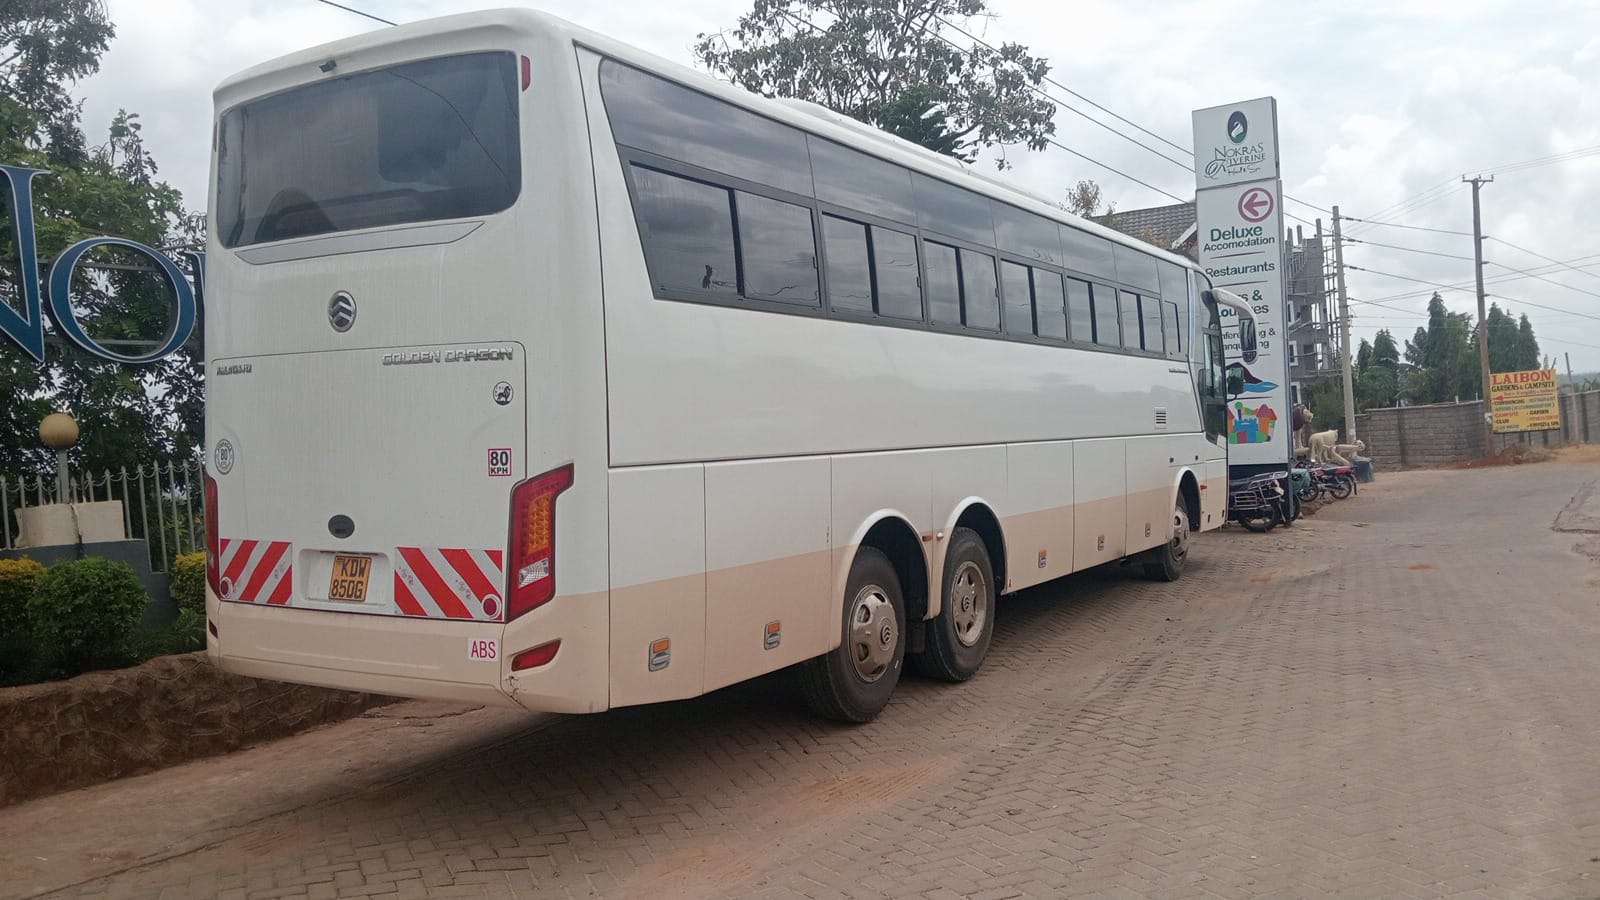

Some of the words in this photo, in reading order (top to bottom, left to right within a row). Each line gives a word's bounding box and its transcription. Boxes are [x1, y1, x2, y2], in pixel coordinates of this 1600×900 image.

[1210, 226, 1263, 242] Deluxe
[1203, 236, 1275, 252] Accomodation
[1204, 261, 1275, 278] Restaurants
[382, 350, 441, 366] GOLDEN
[444, 347, 513, 363] DRAGON
[1492, 371, 1551, 385] LAIBON
[490, 451, 509, 466] 80
[490, 467, 508, 475] KPH
[341, 559, 369, 578] KDW
[331, 578, 365, 600] 850G
[471, 640, 497, 660] ABS
